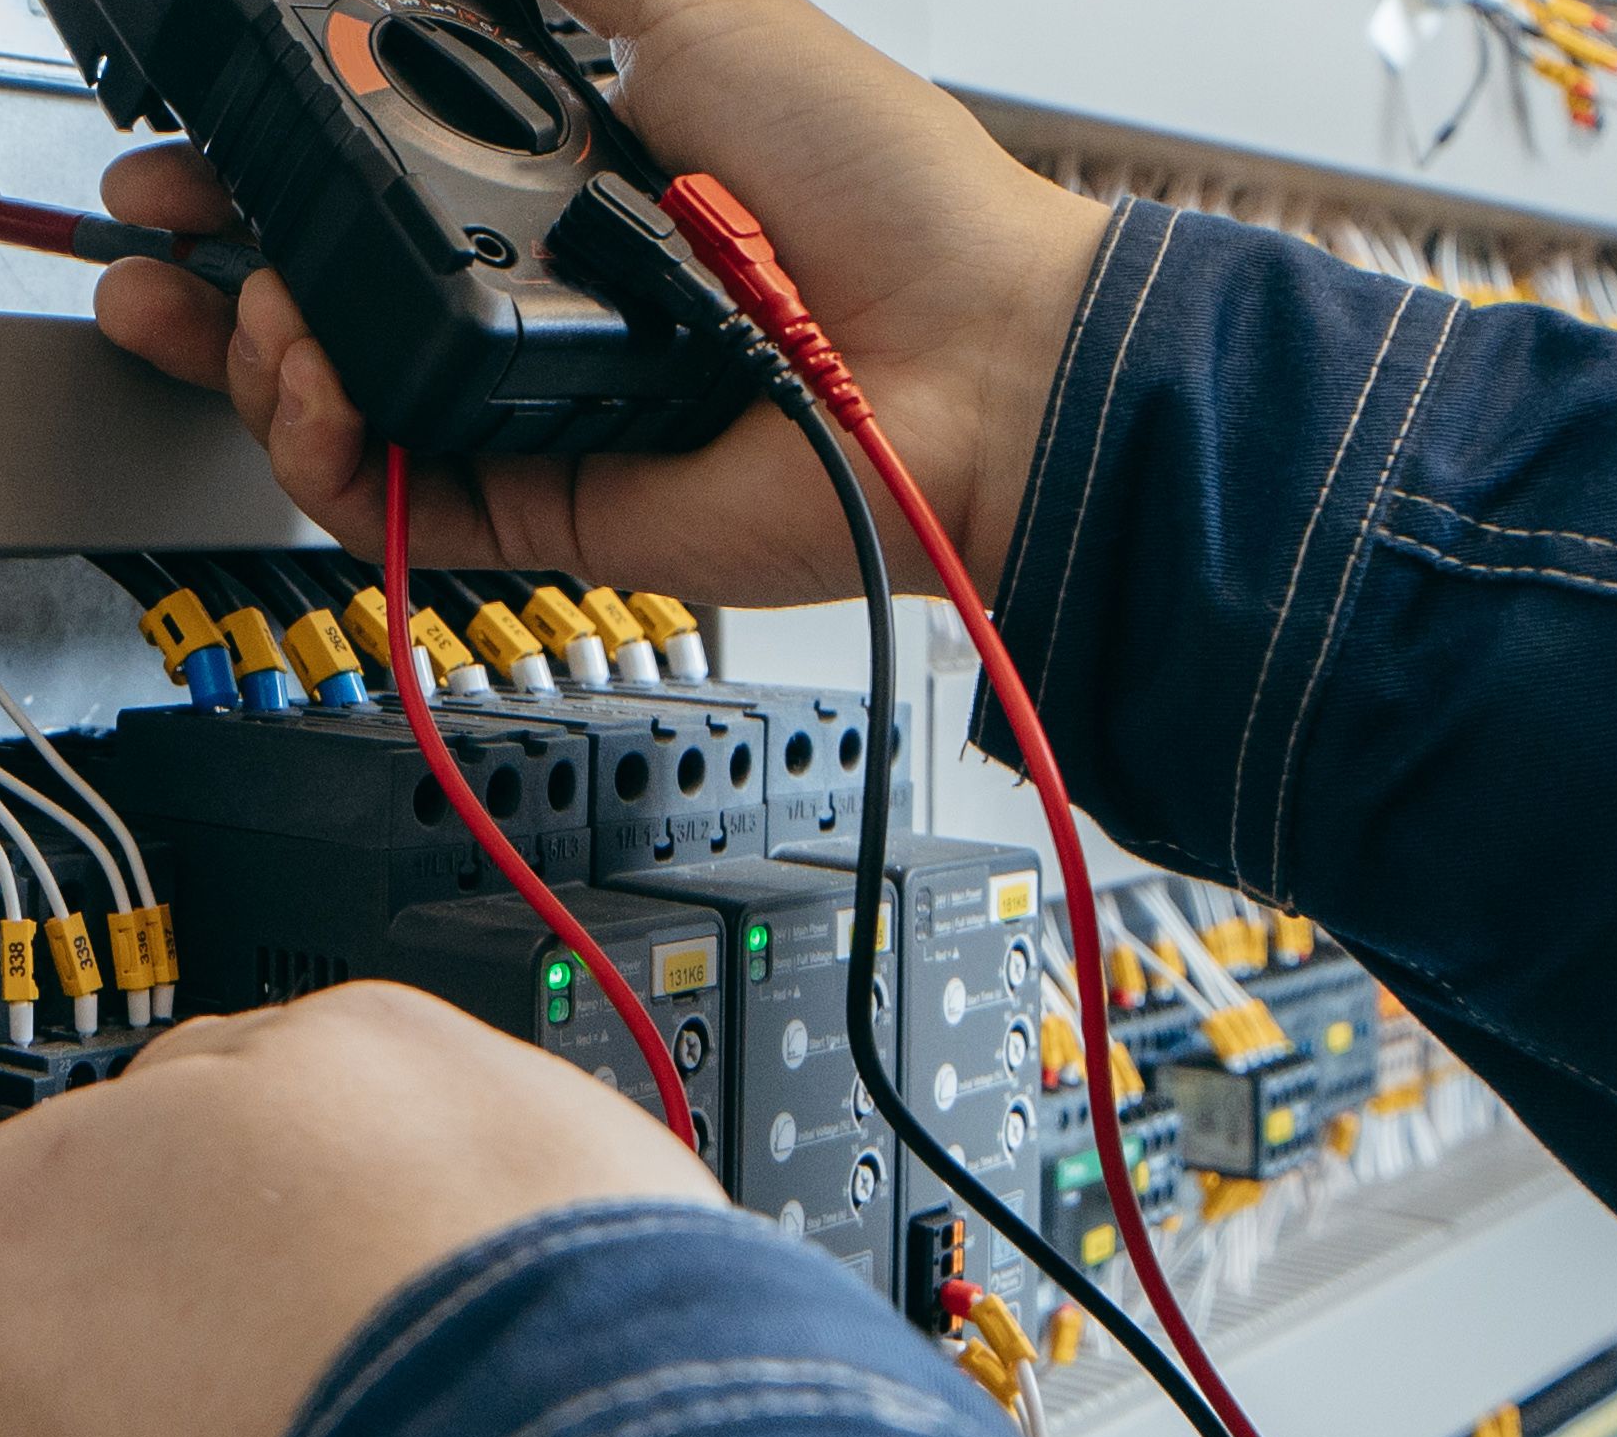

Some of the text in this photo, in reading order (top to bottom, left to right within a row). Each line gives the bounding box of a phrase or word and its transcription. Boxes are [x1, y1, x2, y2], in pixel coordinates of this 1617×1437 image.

[323, 625, 347, 654] 265
[426, 625, 454, 653] 312
[8, 940, 27, 980] 338
[73, 933, 95, 972] 339
[137, 929, 150, 965] 336
[668, 964, 705, 988] 131K6
